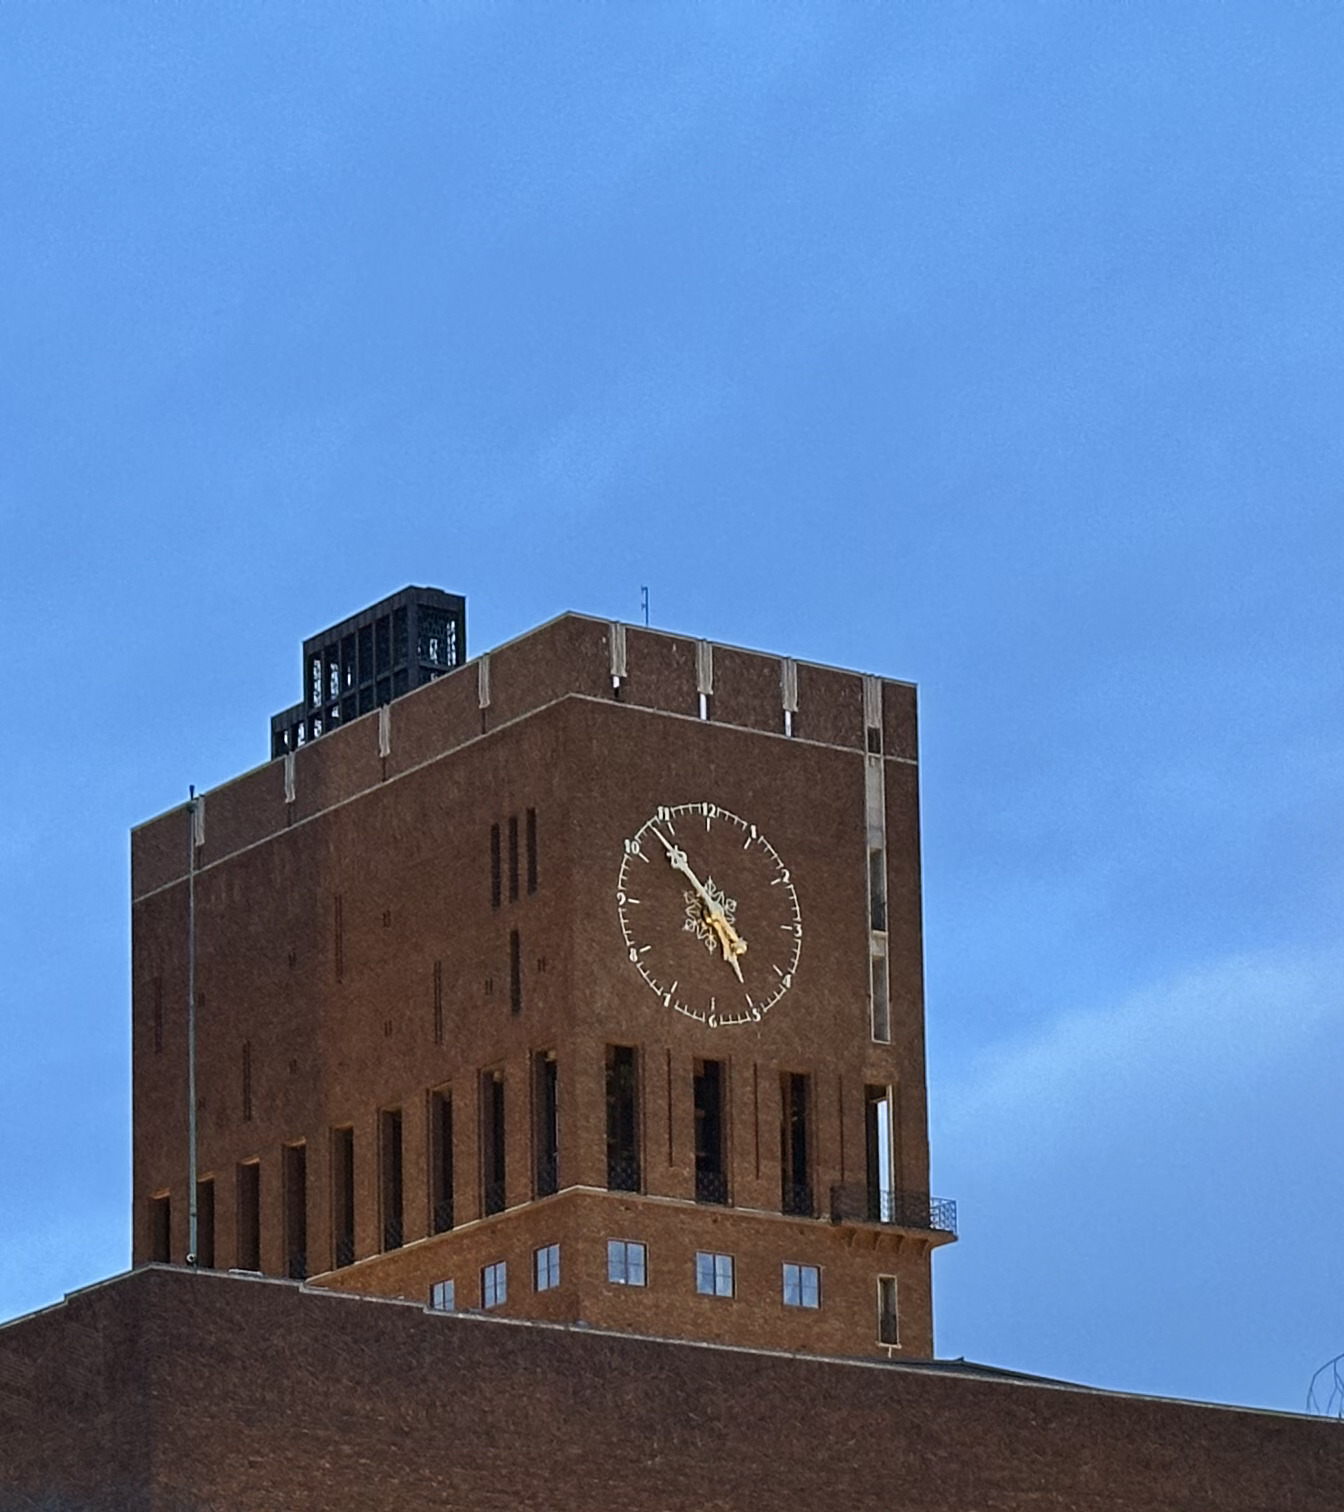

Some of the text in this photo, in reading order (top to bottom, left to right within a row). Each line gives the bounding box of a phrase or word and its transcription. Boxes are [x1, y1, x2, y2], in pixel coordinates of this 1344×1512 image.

[657, 806, 669, 820] 11
[702, 802, 716, 818] 12
[750, 824, 757, 839] 1
[624, 839, 639, 854] 10
[781, 869, 790, 883] 2
[617, 892, 626, 905] 9
[794, 923, 802, 937] 3
[629, 947, 638, 962] 8
[782, 974, 791, 988] 4
[663, 992, 671, 1007] 7
[708, 1014, 717, 1028] 6
[752, 1007, 761, 1021] 5
